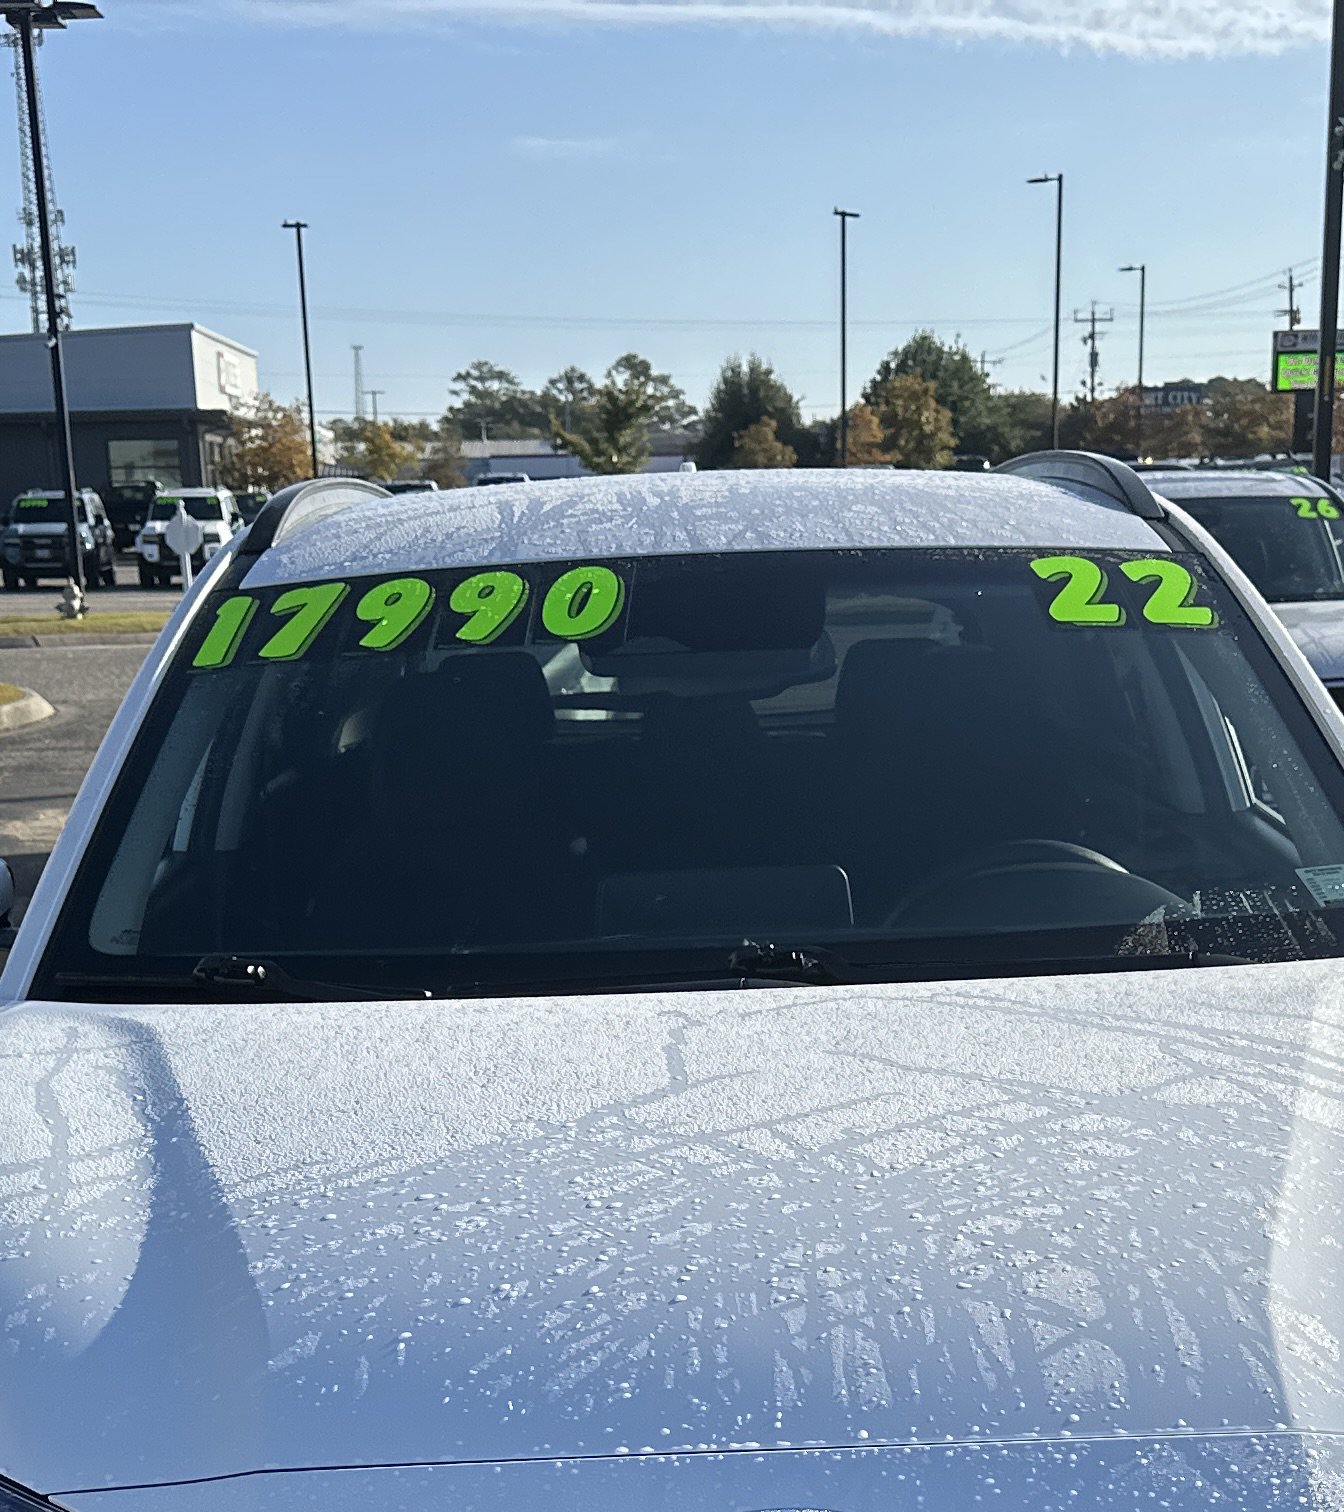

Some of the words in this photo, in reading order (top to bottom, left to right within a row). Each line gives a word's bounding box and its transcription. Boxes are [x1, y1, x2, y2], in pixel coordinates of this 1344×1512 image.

[1289, 498, 1340, 519] 26
[192, 566, 625, 669] 17990
[1030, 556, 1219, 629] 22
